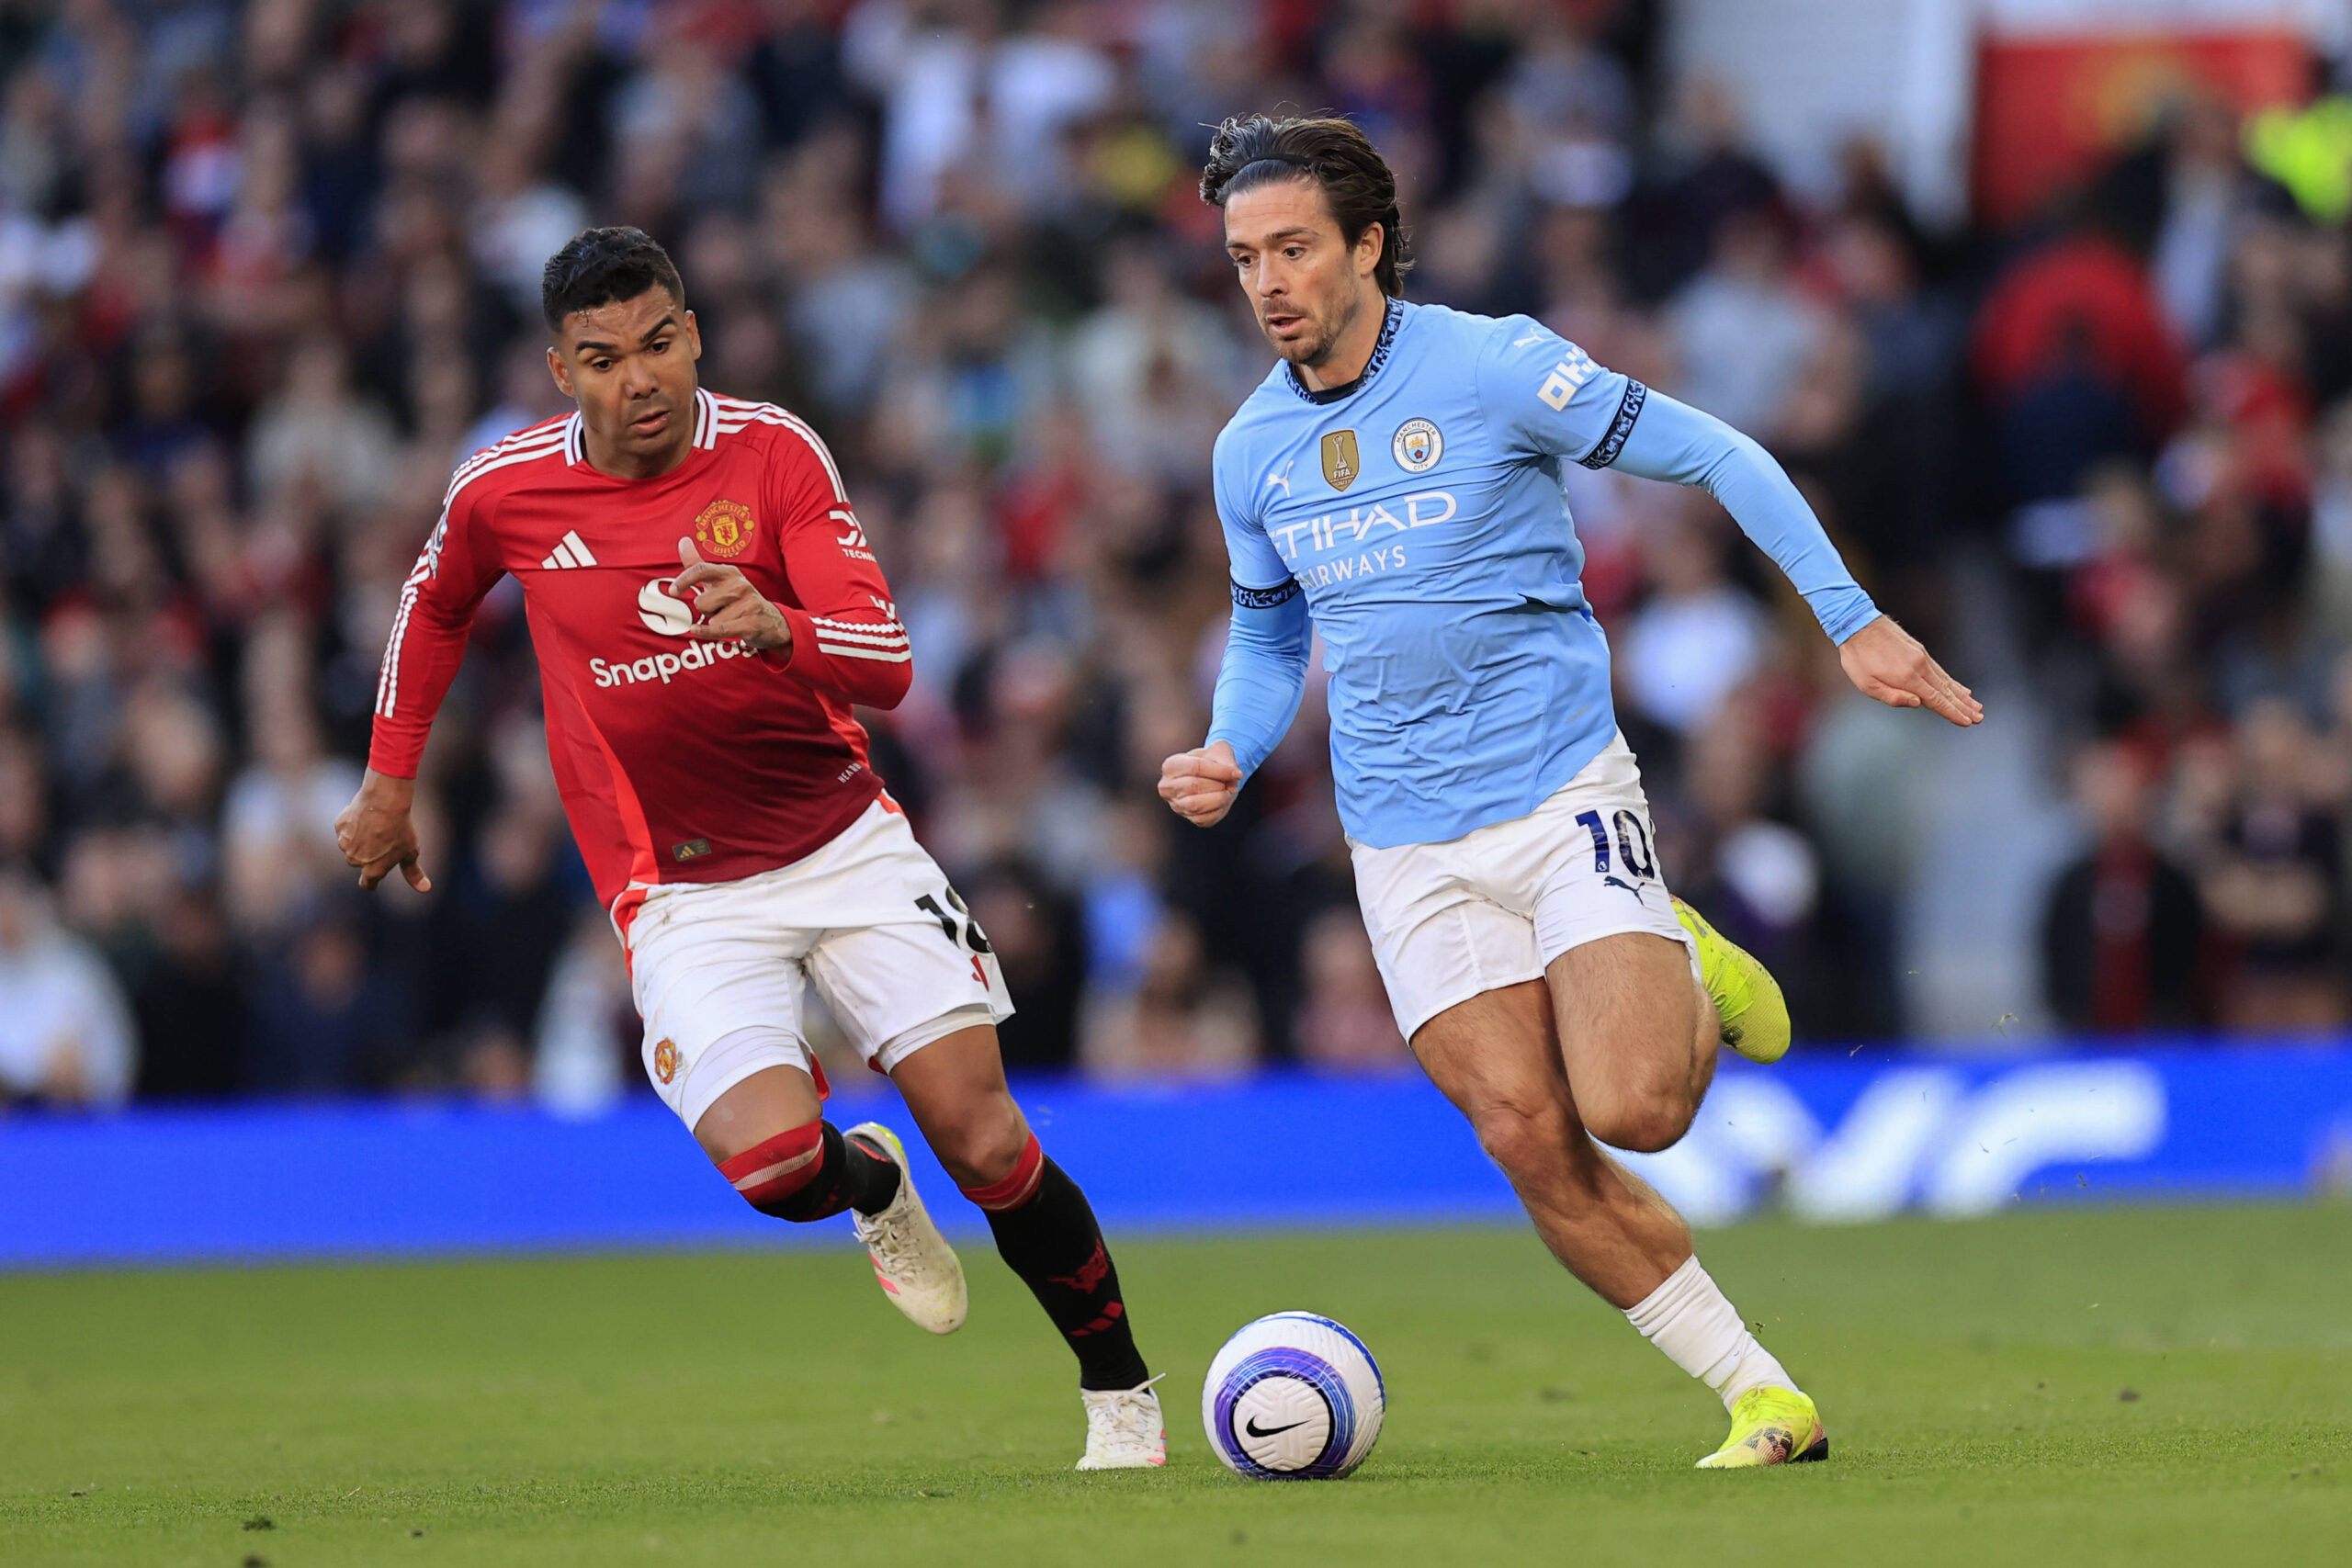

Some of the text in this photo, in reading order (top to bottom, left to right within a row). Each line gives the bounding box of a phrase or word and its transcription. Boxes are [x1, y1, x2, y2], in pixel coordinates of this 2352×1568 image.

[1396, 422, 1437, 444] MANCHESTER
[1333, 467, 1351, 479] FIFA
[1413, 462, 1430, 471] CITY
[699, 503, 747, 527] MANCHESTER
[713, 539, 746, 554] UNITED
[1574, 809, 1656, 882] 10
